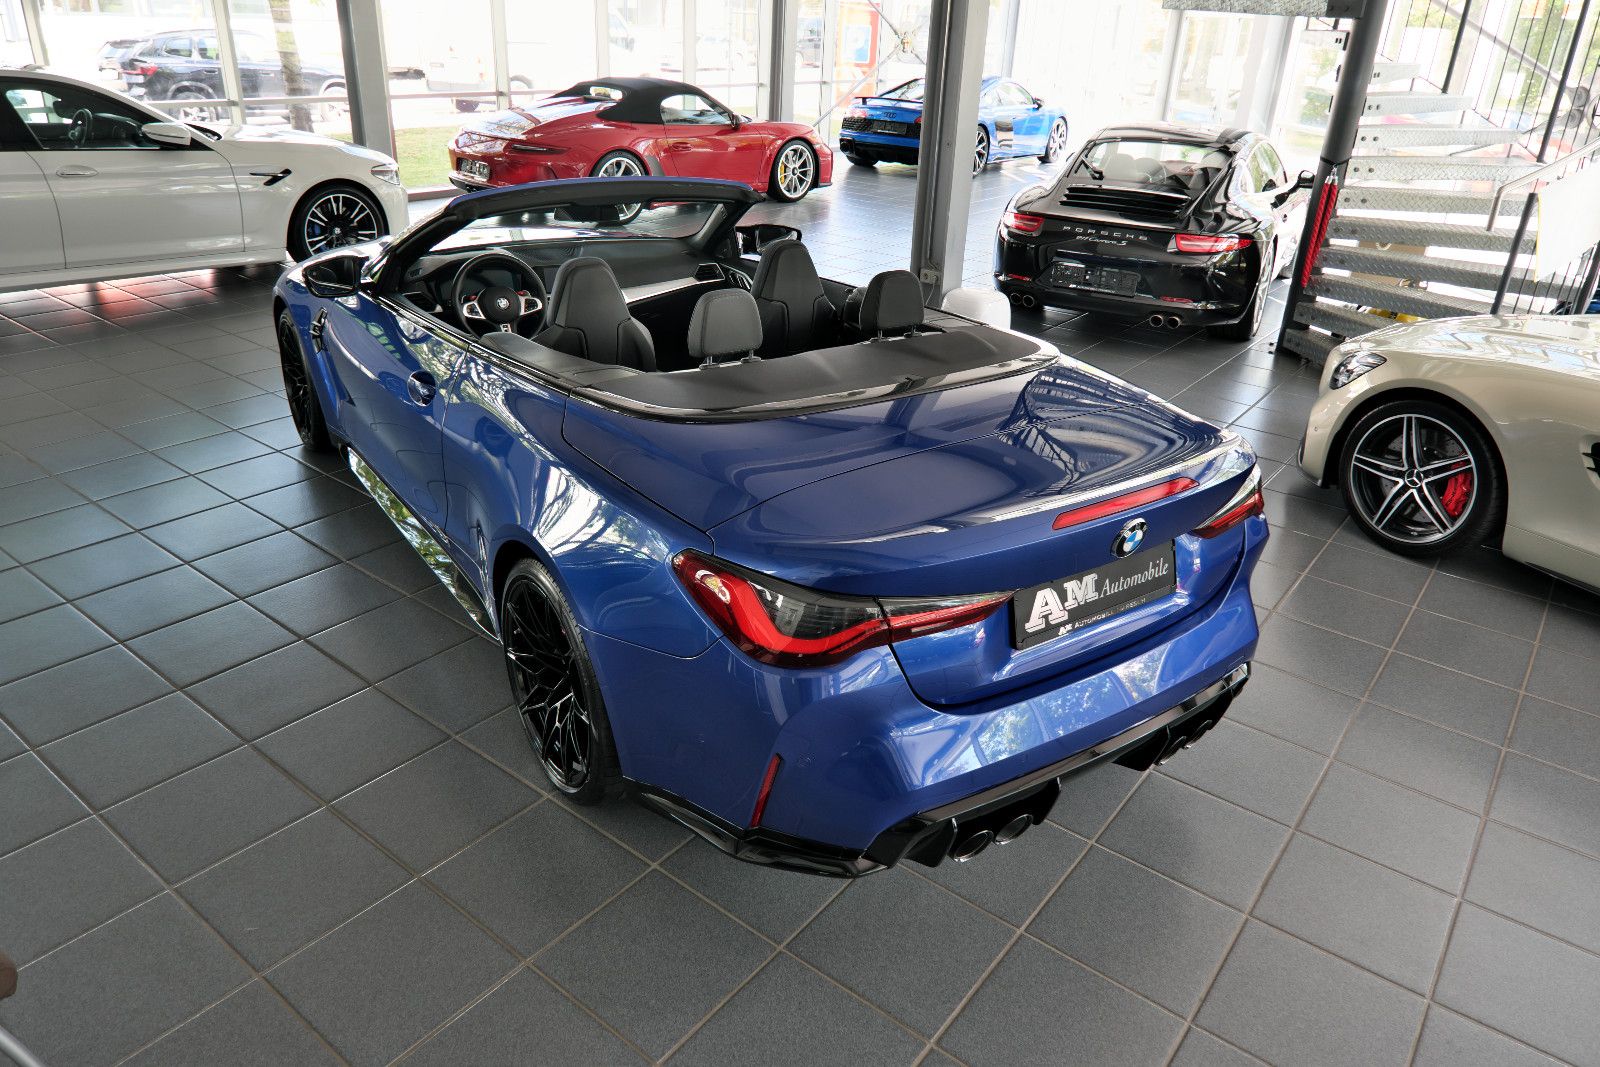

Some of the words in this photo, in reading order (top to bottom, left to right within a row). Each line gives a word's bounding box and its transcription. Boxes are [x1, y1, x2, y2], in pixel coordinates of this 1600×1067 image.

[1062, 226, 1147, 240] PORSCHE
[1025, 573, 1099, 633] AM
[1099, 558, 1168, 598] Automobile
